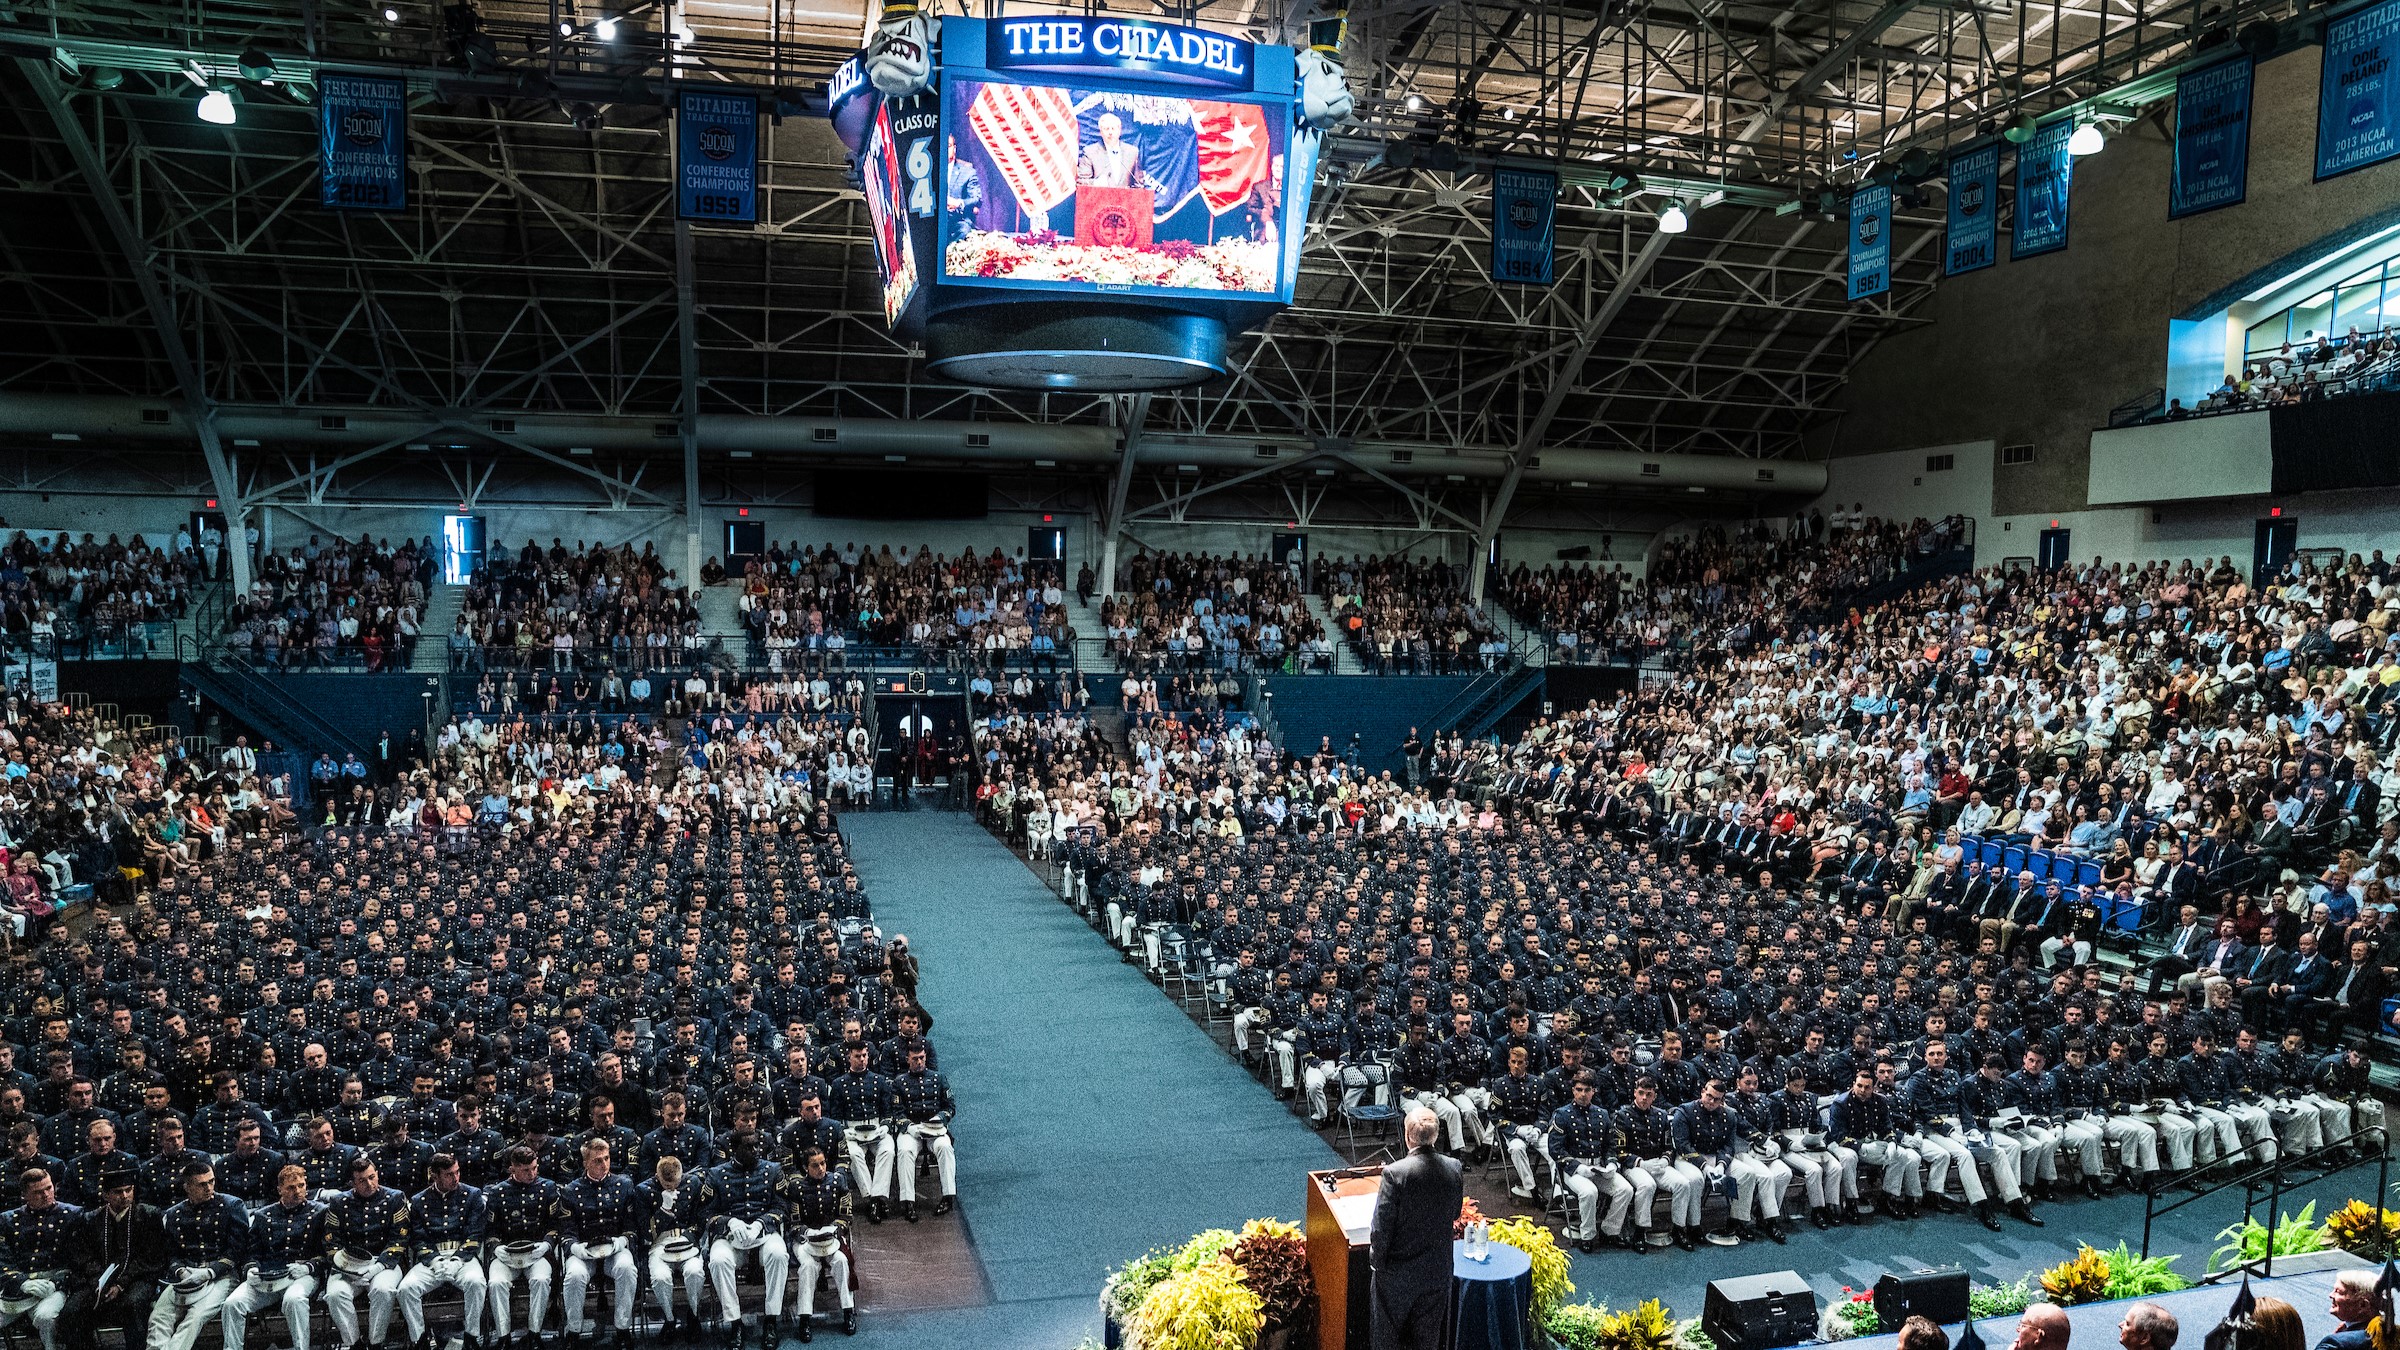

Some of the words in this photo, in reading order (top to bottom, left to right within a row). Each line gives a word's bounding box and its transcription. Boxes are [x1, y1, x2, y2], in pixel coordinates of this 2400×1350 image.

[2330, 20, 2355, 44] THE
[1004, 22, 1084, 54] THE
[1092, 24, 1244, 75] CITADEL
[2352, 46, 2380, 67] ODIE
[2181, 76, 2202, 97] THE
[2203, 61, 2249, 91] CITADEL
[2341, 58, 2390, 87] DELANEY
[324, 80, 348, 97] THE
[351, 82, 400, 99] CITADEL
[2182, 79, 2245, 107] WRESTLING
[2346, 85, 2363, 99] 285
[324, 97, 357, 107] WOMEN'S
[359, 99, 400, 110] VOLLEYBALL
[686, 97, 751, 116] CITADEL
[686, 112, 714, 123] TRACK
[724, 116, 751, 125] FIELD
[895, 116, 922, 134] CLASS
[924, 114, 938, 129] OF
[2351, 110, 2375, 125] NCAA
[2036, 125, 2069, 149] CITADEL
[2335, 137, 2356, 153] 2013
[2361, 127, 2386, 144] NCAA
[329, 151, 398, 165] CONFERENCE
[1953, 151, 1995, 176] CITADEL
[2325, 139, 2394, 170] ALL-AMERICAN
[329, 165, 398, 179] CHAMPIONS
[686, 164, 750, 179] CONFERENCE
[1953, 164, 1994, 185] WRESTLING
[686, 177, 750, 192] CHAMPIONS
[1499, 174, 1550, 191] CITADEL
[2186, 182, 2205, 196] 2013
[2207, 174, 2229, 188] NCAA
[1501, 187, 1525, 198] MEN'S
[1528, 191, 1549, 199] GOLF
[1853, 187, 1889, 209] CITADEL
[2177, 186, 2235, 209] ALL-AMERICAN
[695, 195, 740, 215] 1959
[1853, 201, 1889, 217] WRESTLING
[1500, 239, 1549, 252] CHAMPIONS
[1951, 229, 1990, 249] CHAMPIONS
[1852, 245, 1886, 263] TOURNAMENT
[1954, 244, 1986, 269] 2004
[1852, 255, 1885, 275] CHAMPIONS
[1856, 273, 1880, 294] 1967
[427, 677, 438, 685] 35
[876, 677, 886, 685] 36
[947, 677, 957, 685] 37
